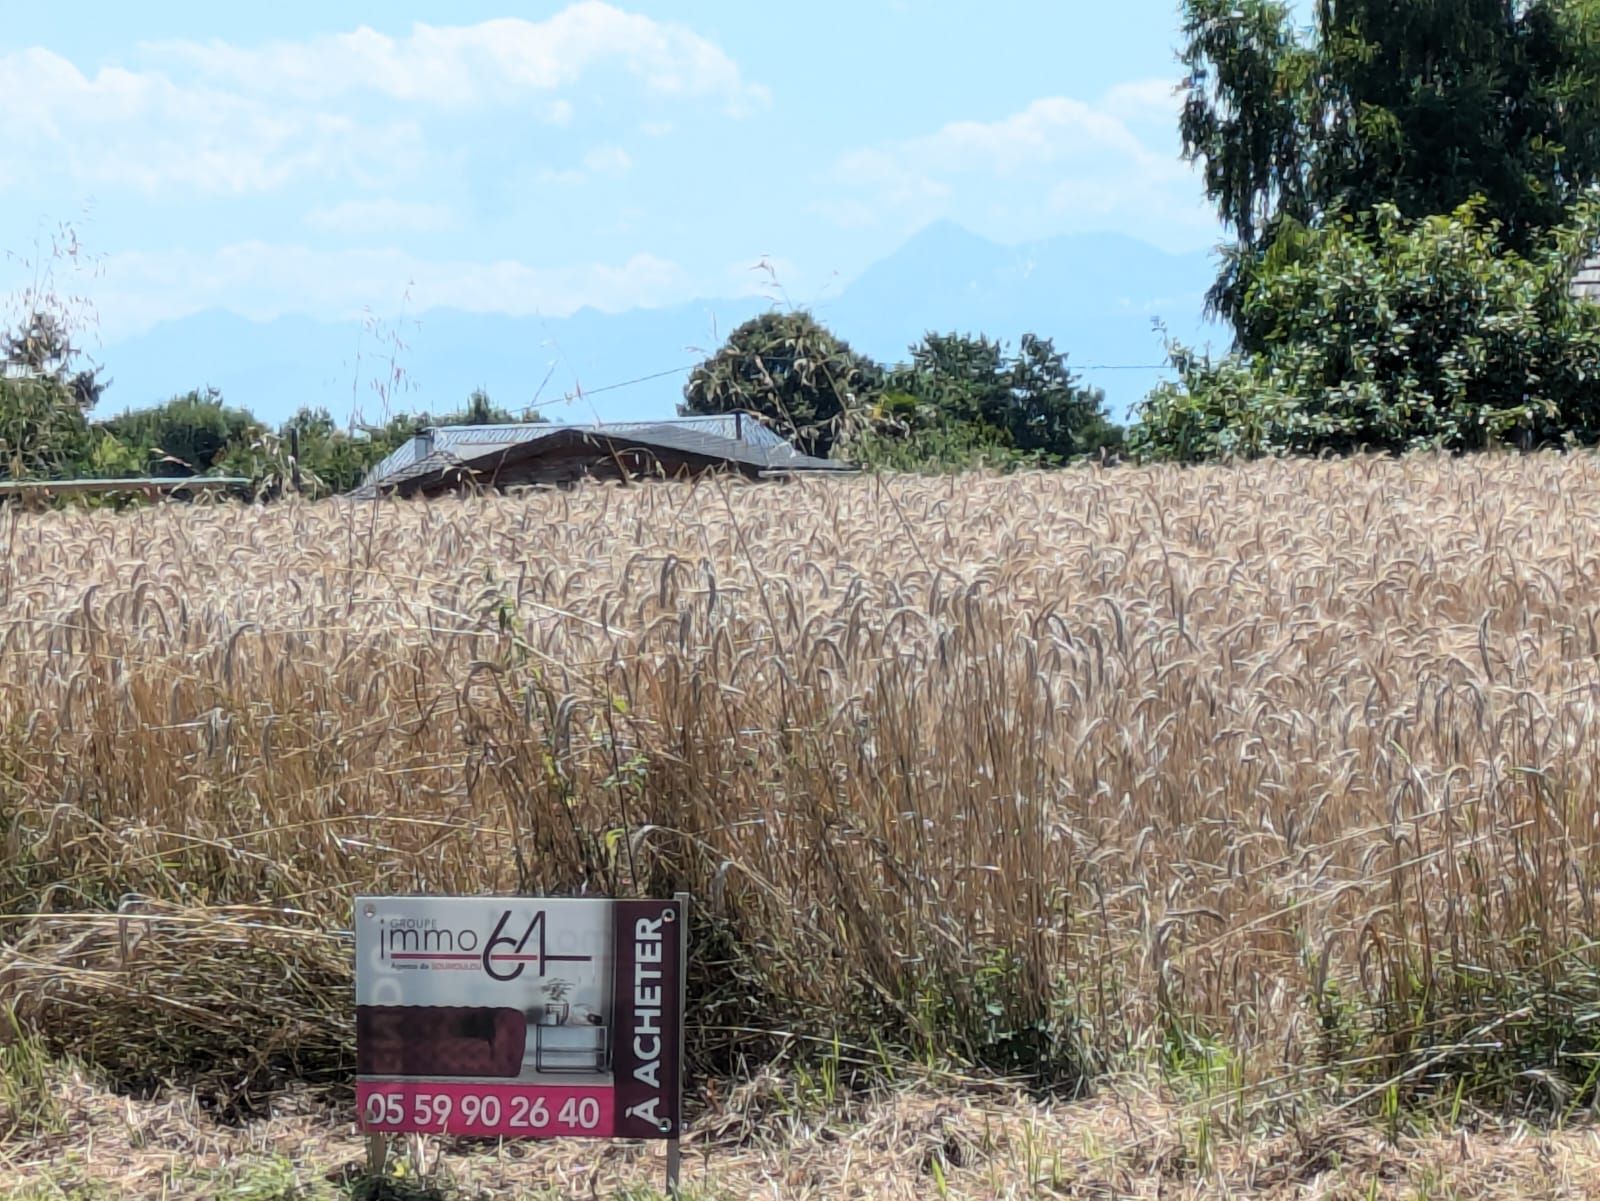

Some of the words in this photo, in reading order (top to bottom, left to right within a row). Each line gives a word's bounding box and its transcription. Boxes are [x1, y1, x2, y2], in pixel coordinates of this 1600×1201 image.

[390, 919, 437, 929] GROUPE
[633, 917, 663, 1089] ACHETER
[366, 1093, 405, 1125] 05
[413, 1094, 453, 1126] 59
[460, 1095, 501, 1127] 90
[509, 1096, 550, 1128] 26
[557, 1097, 601, 1130] 40
